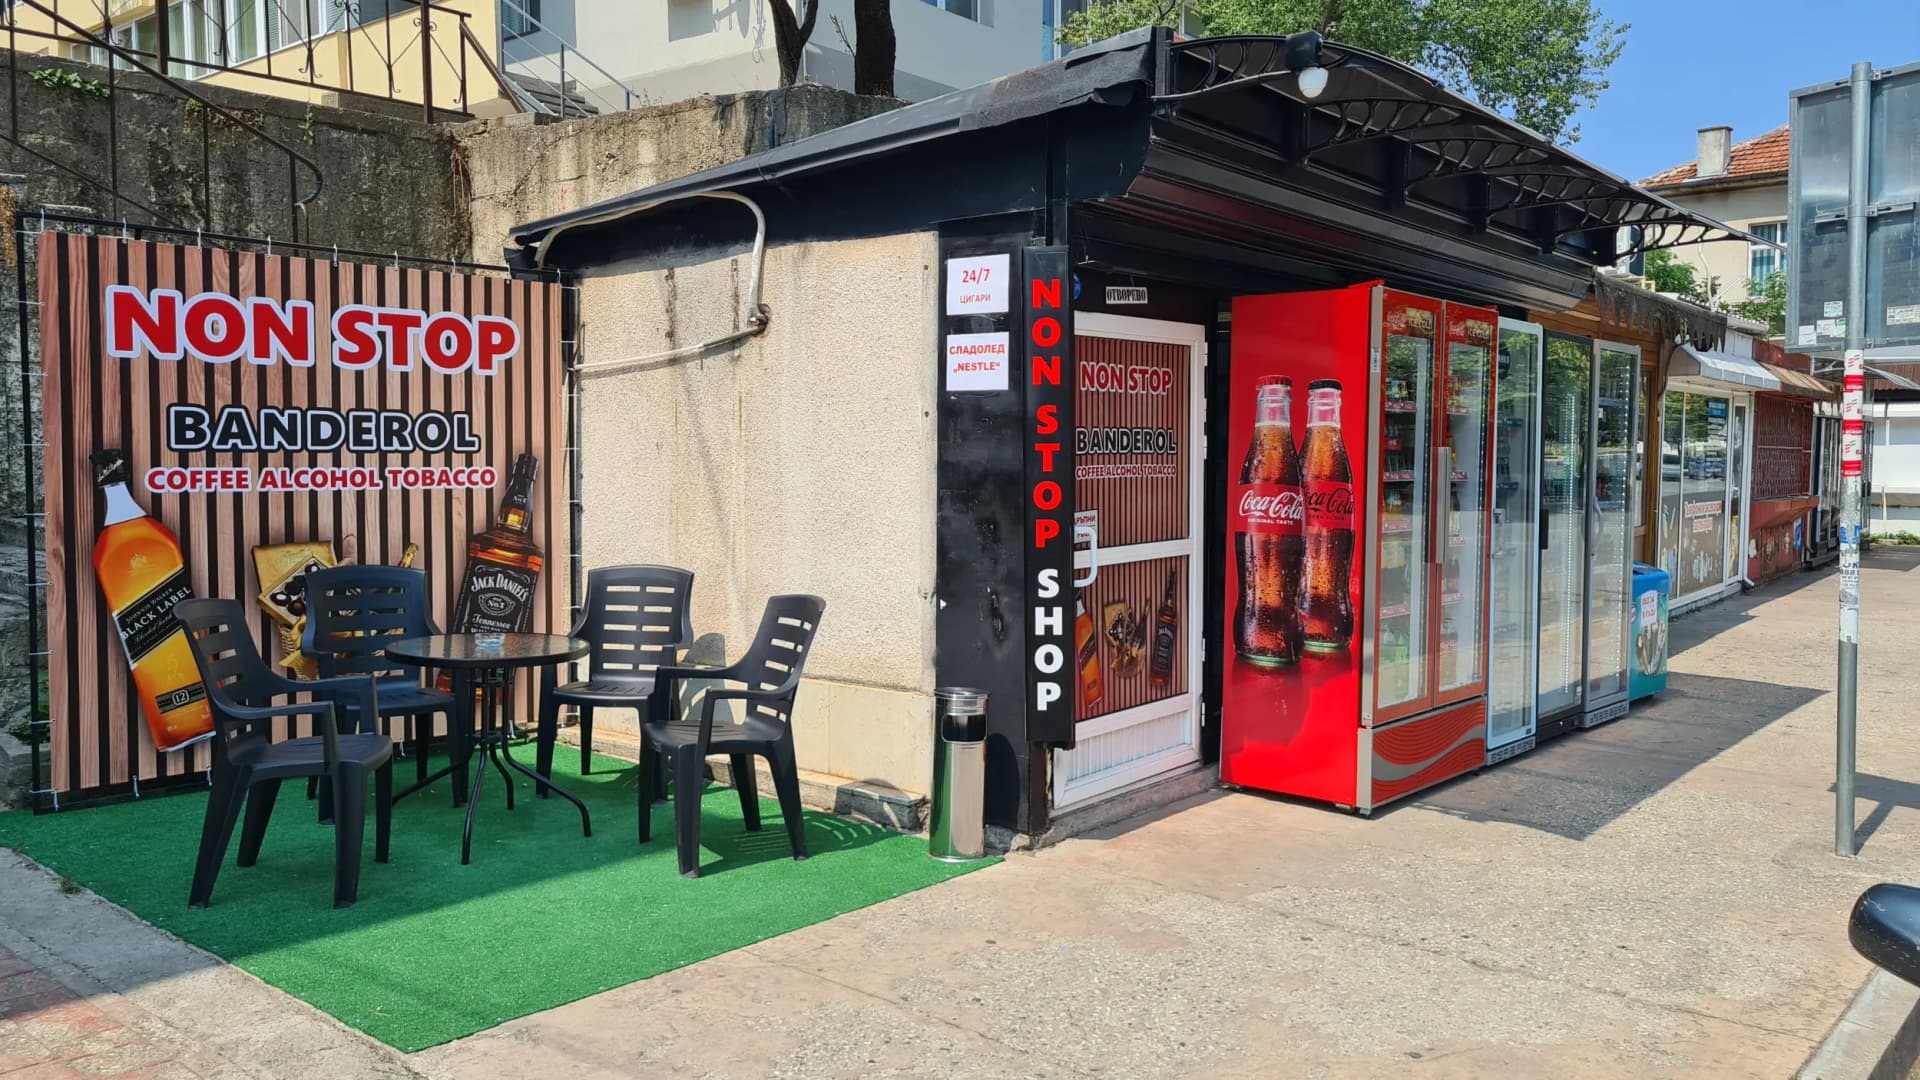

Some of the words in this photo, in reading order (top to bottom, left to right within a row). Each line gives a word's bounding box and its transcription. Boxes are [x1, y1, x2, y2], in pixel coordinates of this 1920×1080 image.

[961, 268, 991, 284] 24/7
[960, 294, 991, 304] ЦИГАРИ
[1106, 288, 1146, 301] ОТВОРЕНО
[107, 286, 313, 366] NON
[333, 306, 519, 374] STOP
[1032, 279, 1062, 385] NON
[949, 343, 1006, 355] СЛАДОЛЕД
[1080, 362, 1124, 392] NON
[1128, 366, 1172, 394] STOP
[170, 405, 480, 452] BANDEROL
[1076, 428, 1177, 454] BANDEROL
[146, 469, 249, 492] COFFEE
[259, 468, 381, 490] ALCOHOL
[387, 468, 497, 489] TOBACCO
[1032, 405, 1063, 548] STOP
[1076, 466, 1104, 479] COFFEE
[1106, 465, 1142, 477] ALCOHOL
[1143, 465, 1177, 477] TOBACCO
[1239, 490, 1303, 520] Coca-Cola
[471, 576, 495, 592] JACK
[120, 611, 157, 640] BLACK
[157, 586, 192, 613] LABEL
[1034, 568, 1064, 711] SHOP
[175, 692, 187, 703] 12
